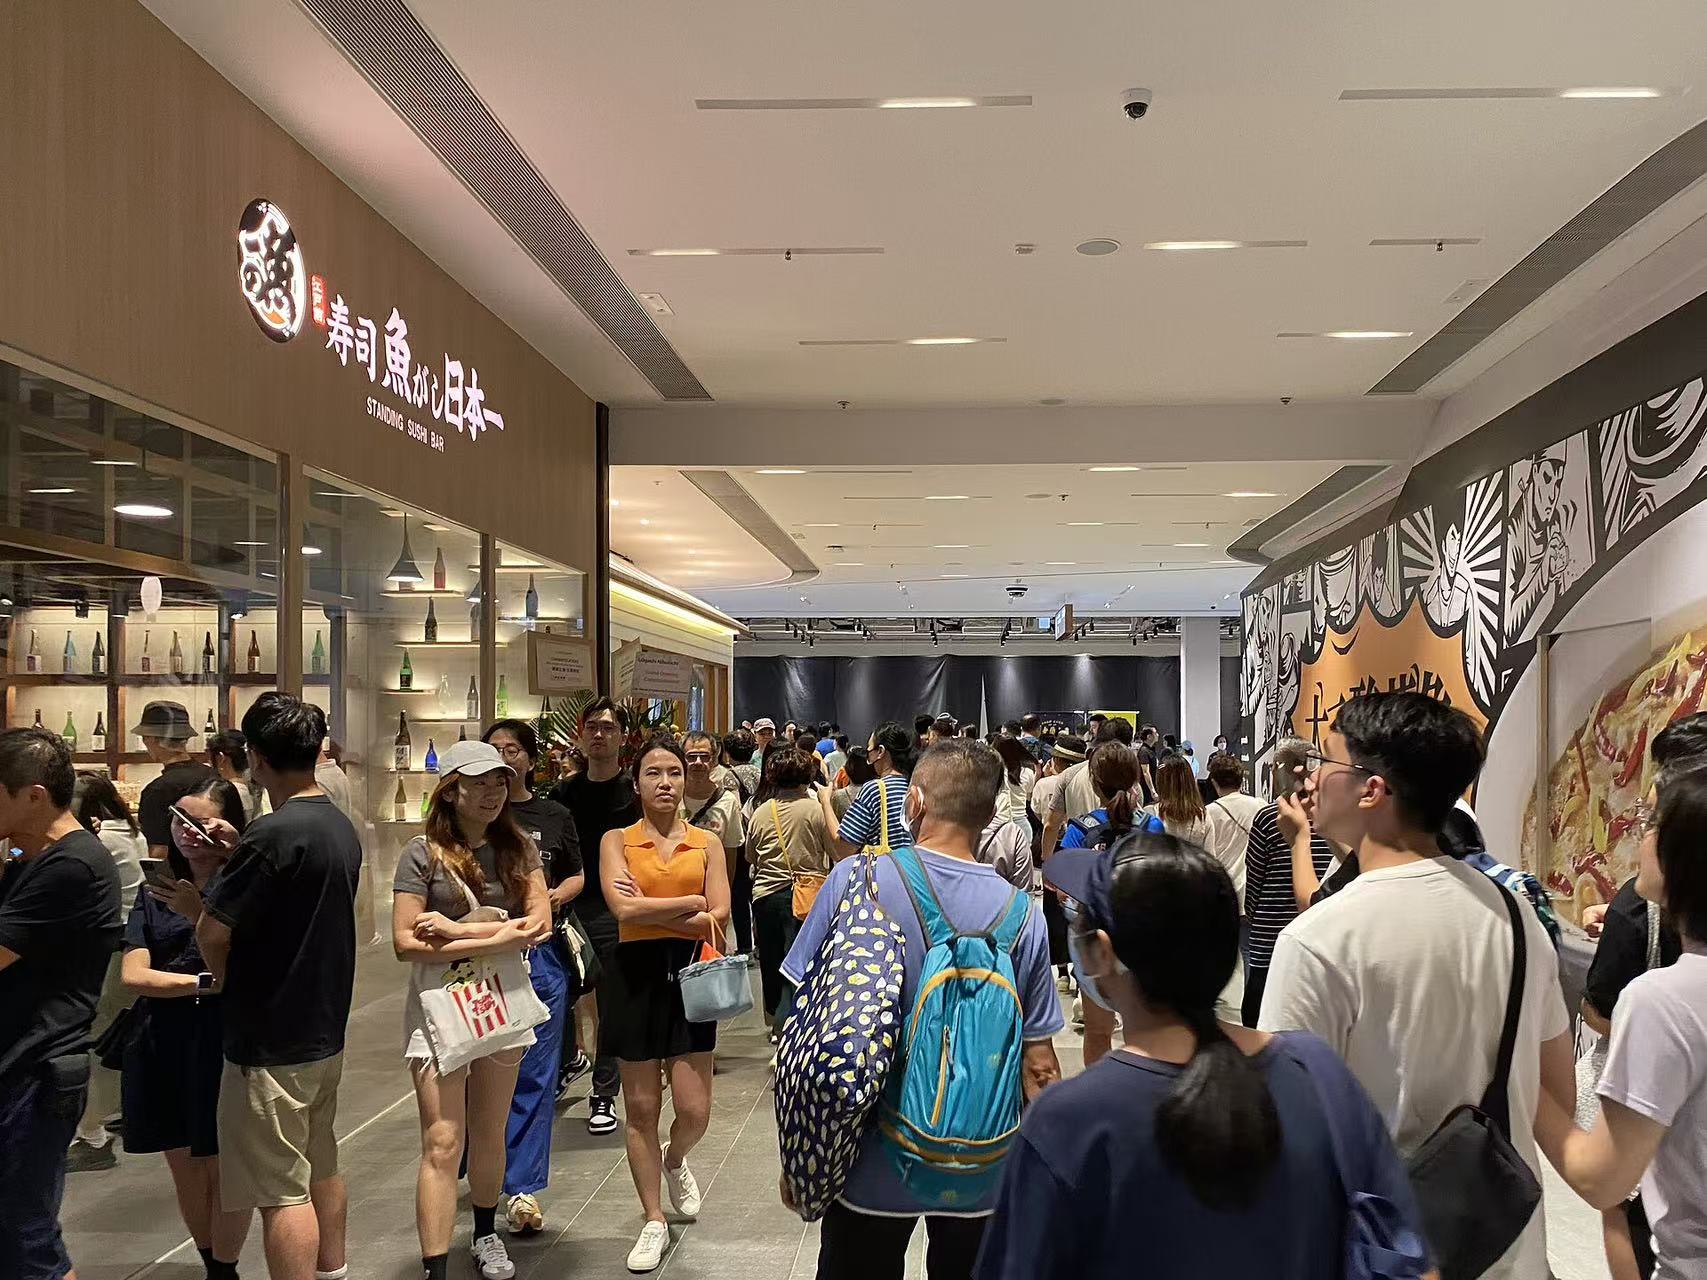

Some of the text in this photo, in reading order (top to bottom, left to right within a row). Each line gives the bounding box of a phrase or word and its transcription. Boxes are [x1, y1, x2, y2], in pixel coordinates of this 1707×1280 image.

[366, 396, 444, 453] STANDING SUSHI BAR
